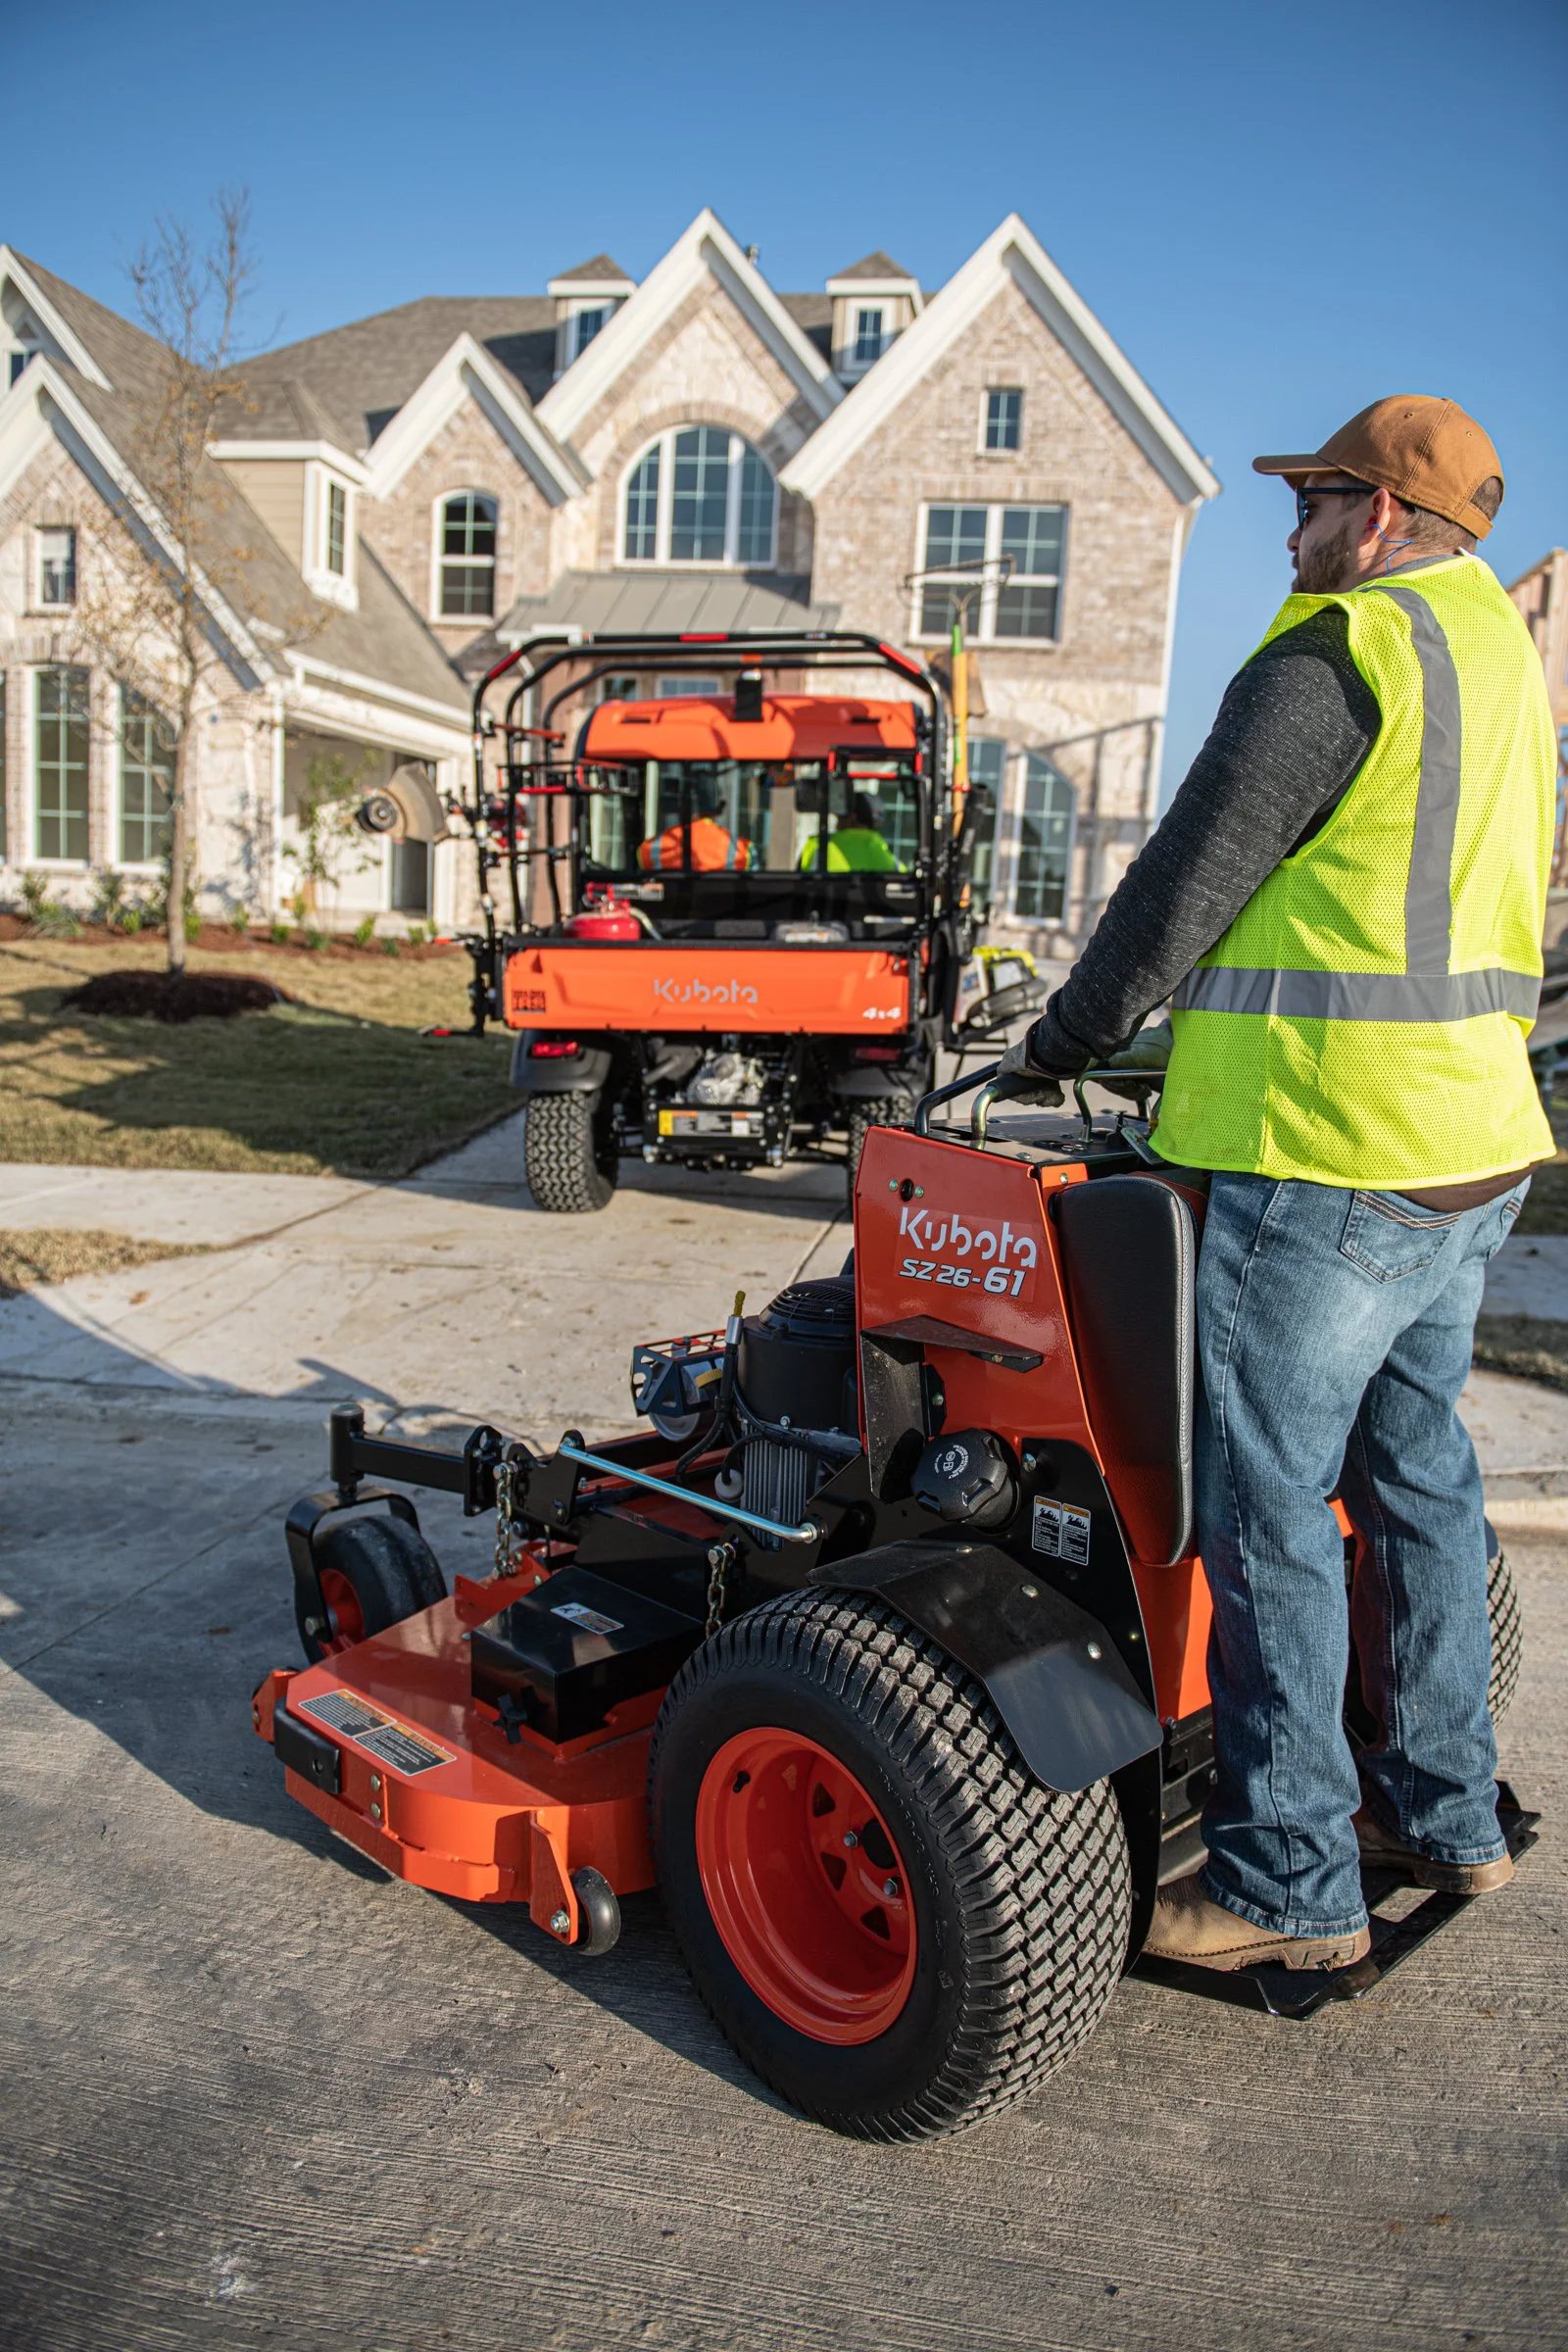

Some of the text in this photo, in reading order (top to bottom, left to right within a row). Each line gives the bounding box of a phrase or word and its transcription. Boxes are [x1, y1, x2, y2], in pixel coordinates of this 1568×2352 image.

[654, 979, 759, 1004] Kubota
[861, 1006, 903, 1020] 4x4
[899, 1206, 1037, 1268] Kubota
